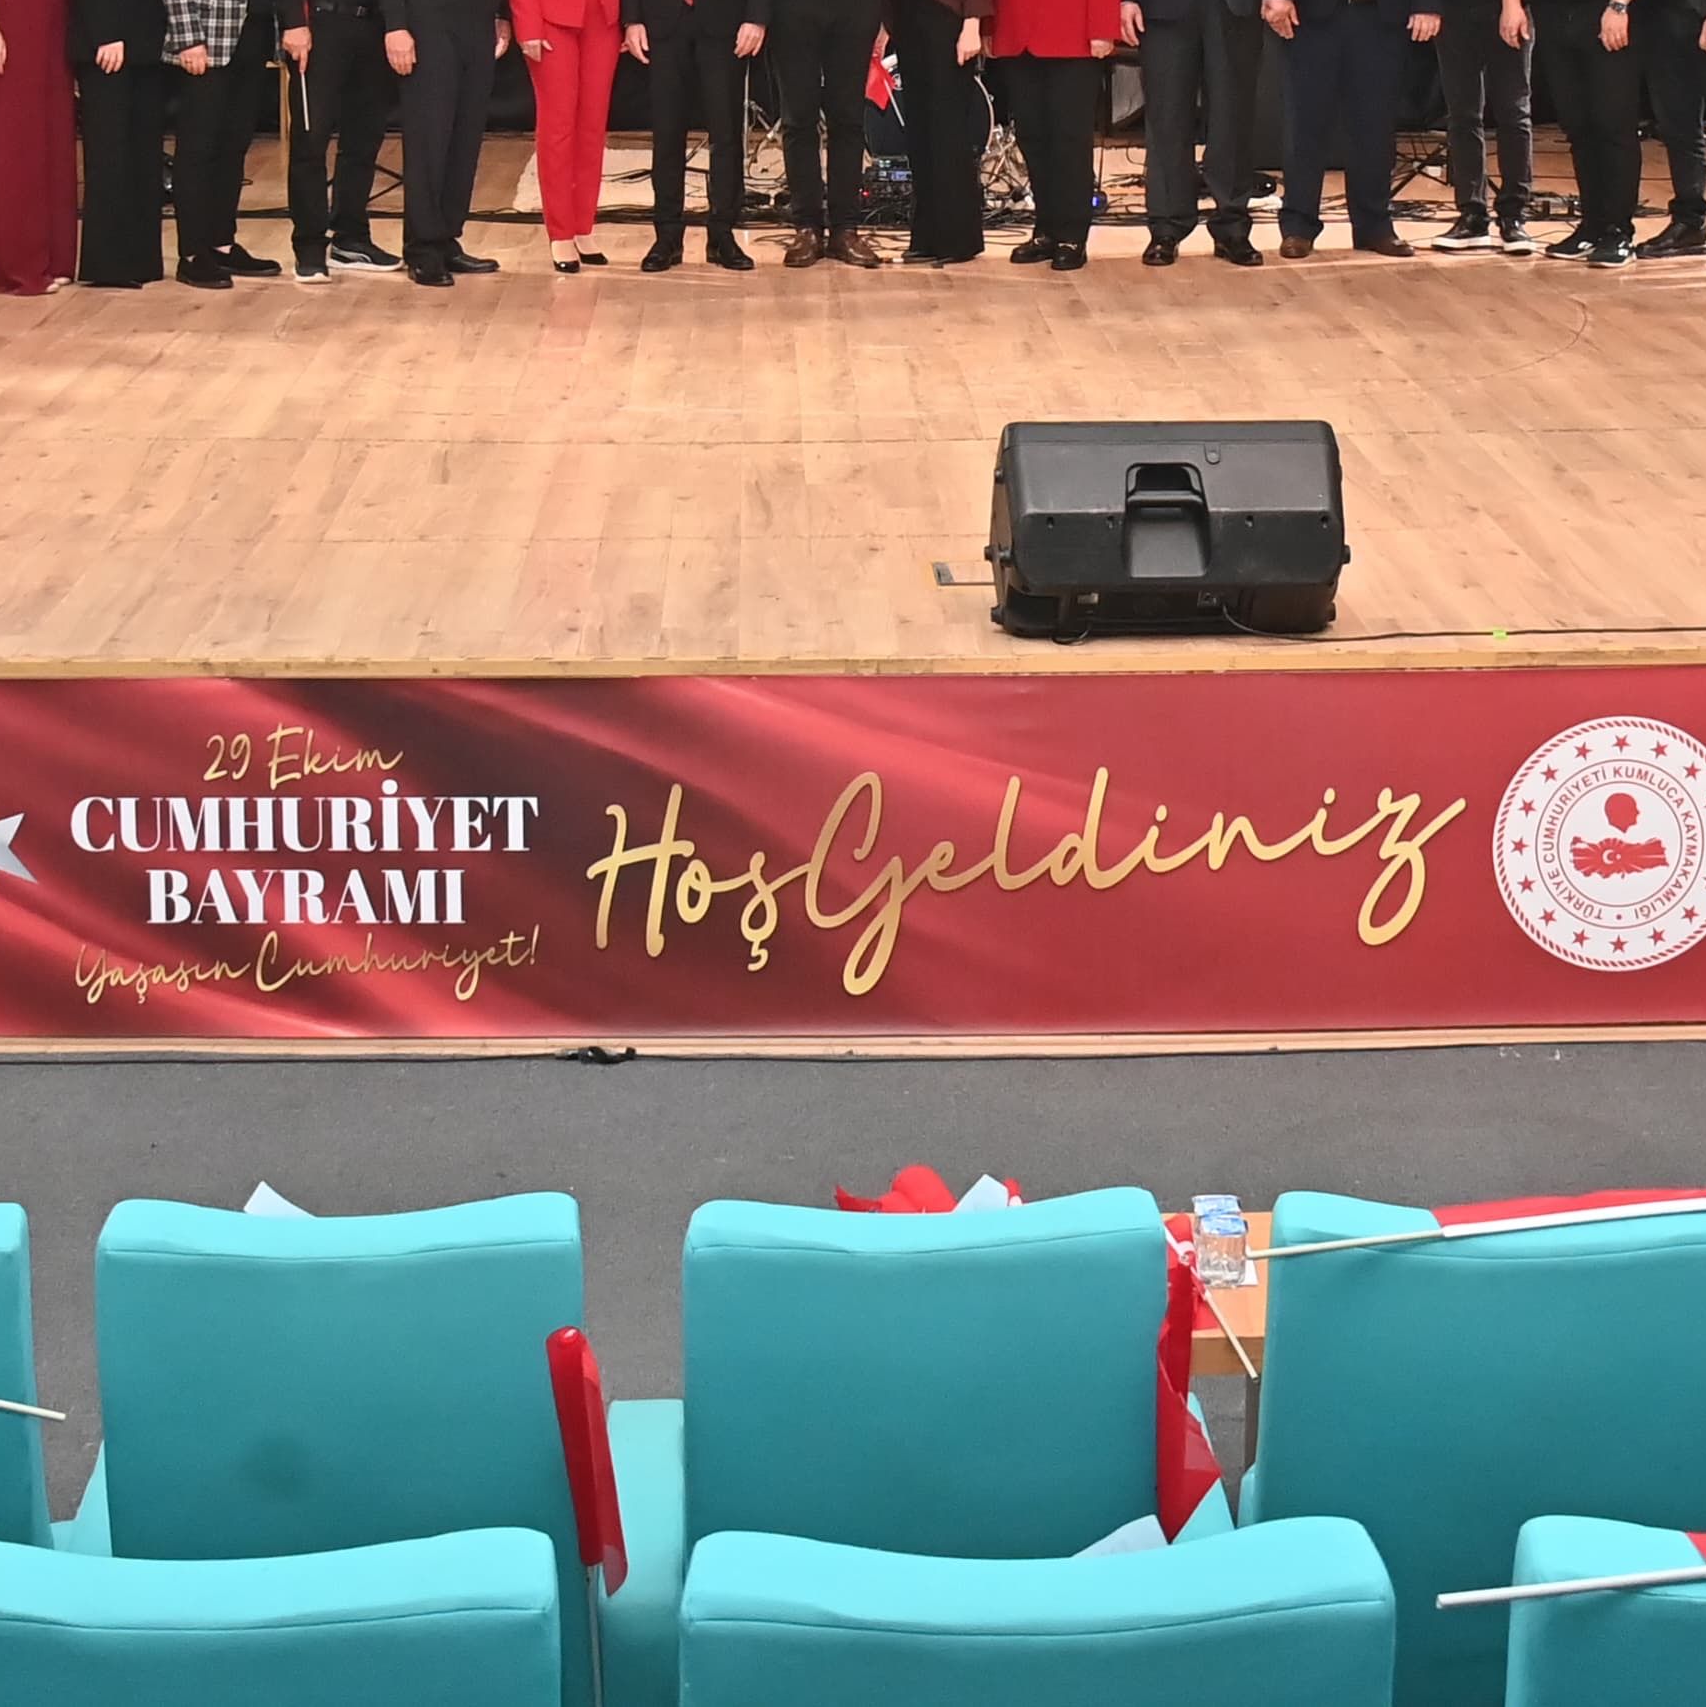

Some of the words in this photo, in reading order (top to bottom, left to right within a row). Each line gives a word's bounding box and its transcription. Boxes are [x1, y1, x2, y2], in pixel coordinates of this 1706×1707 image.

[204, 734, 252, 782] 29
[266, 723, 402, 791] Ekim
[70, 778, 540, 852] CUMHURİYET
[1542, 765, 1607, 863] CUMHURİYETİ
[1612, 765, 1685, 809] KUMLUCA
[146, 869, 466, 925] BAYRAMI
[74, 942, 251, 1003] Yaşasın
[255, 925, 540, 1000] Cumhuriyet!
